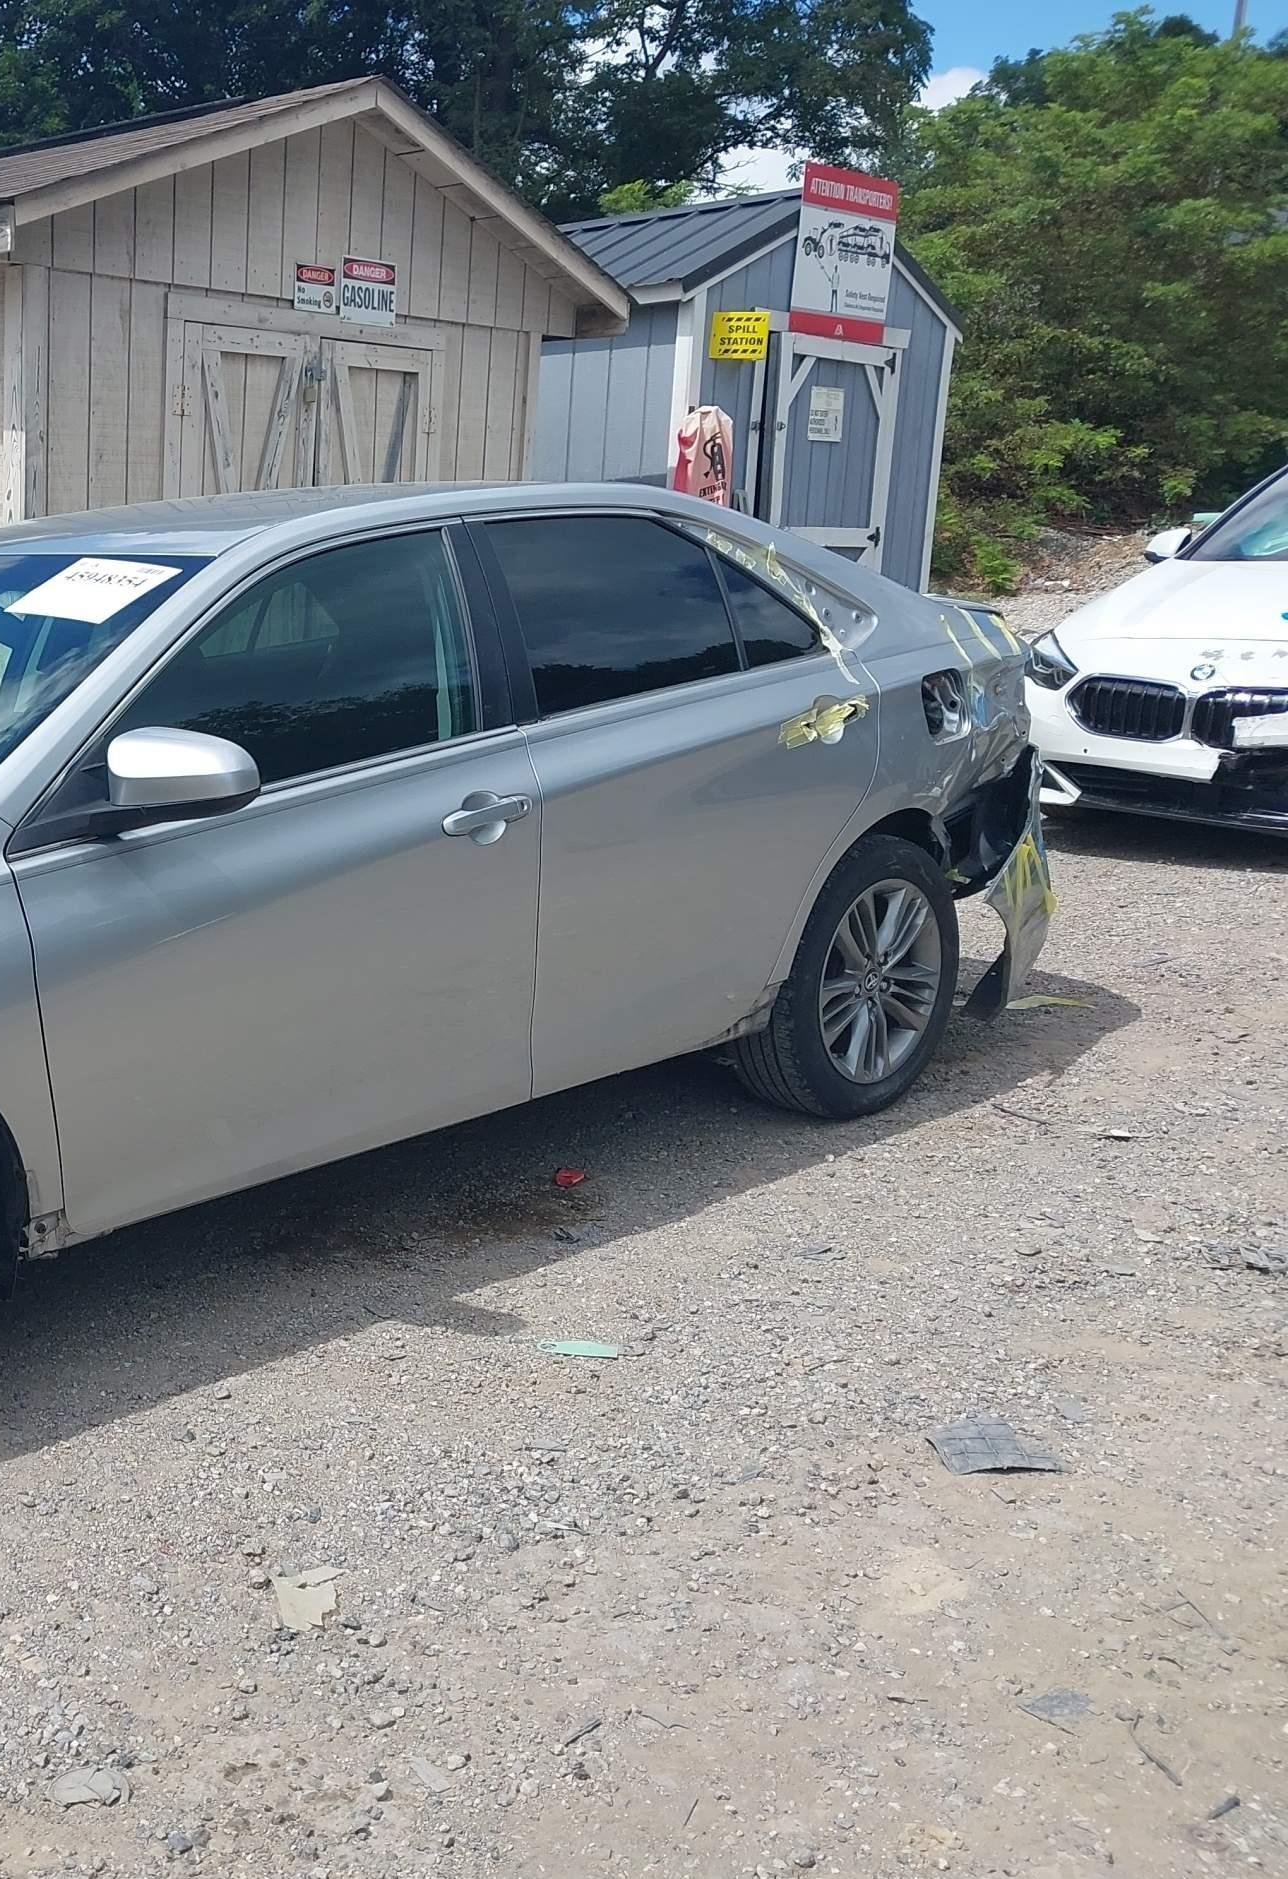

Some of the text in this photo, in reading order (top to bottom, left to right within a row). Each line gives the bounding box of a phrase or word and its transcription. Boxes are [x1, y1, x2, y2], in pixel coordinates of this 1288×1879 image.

[810, 178, 845, 200] ATTENTION
[302, 269, 329, 281] DANGER
[352, 264, 387, 279] DANGER
[297, 296, 321, 309] Smoking
[342, 284, 395, 313] GASOLINE
[728, 325, 758, 334] SPILL
[719, 336, 763, 346] STATION
